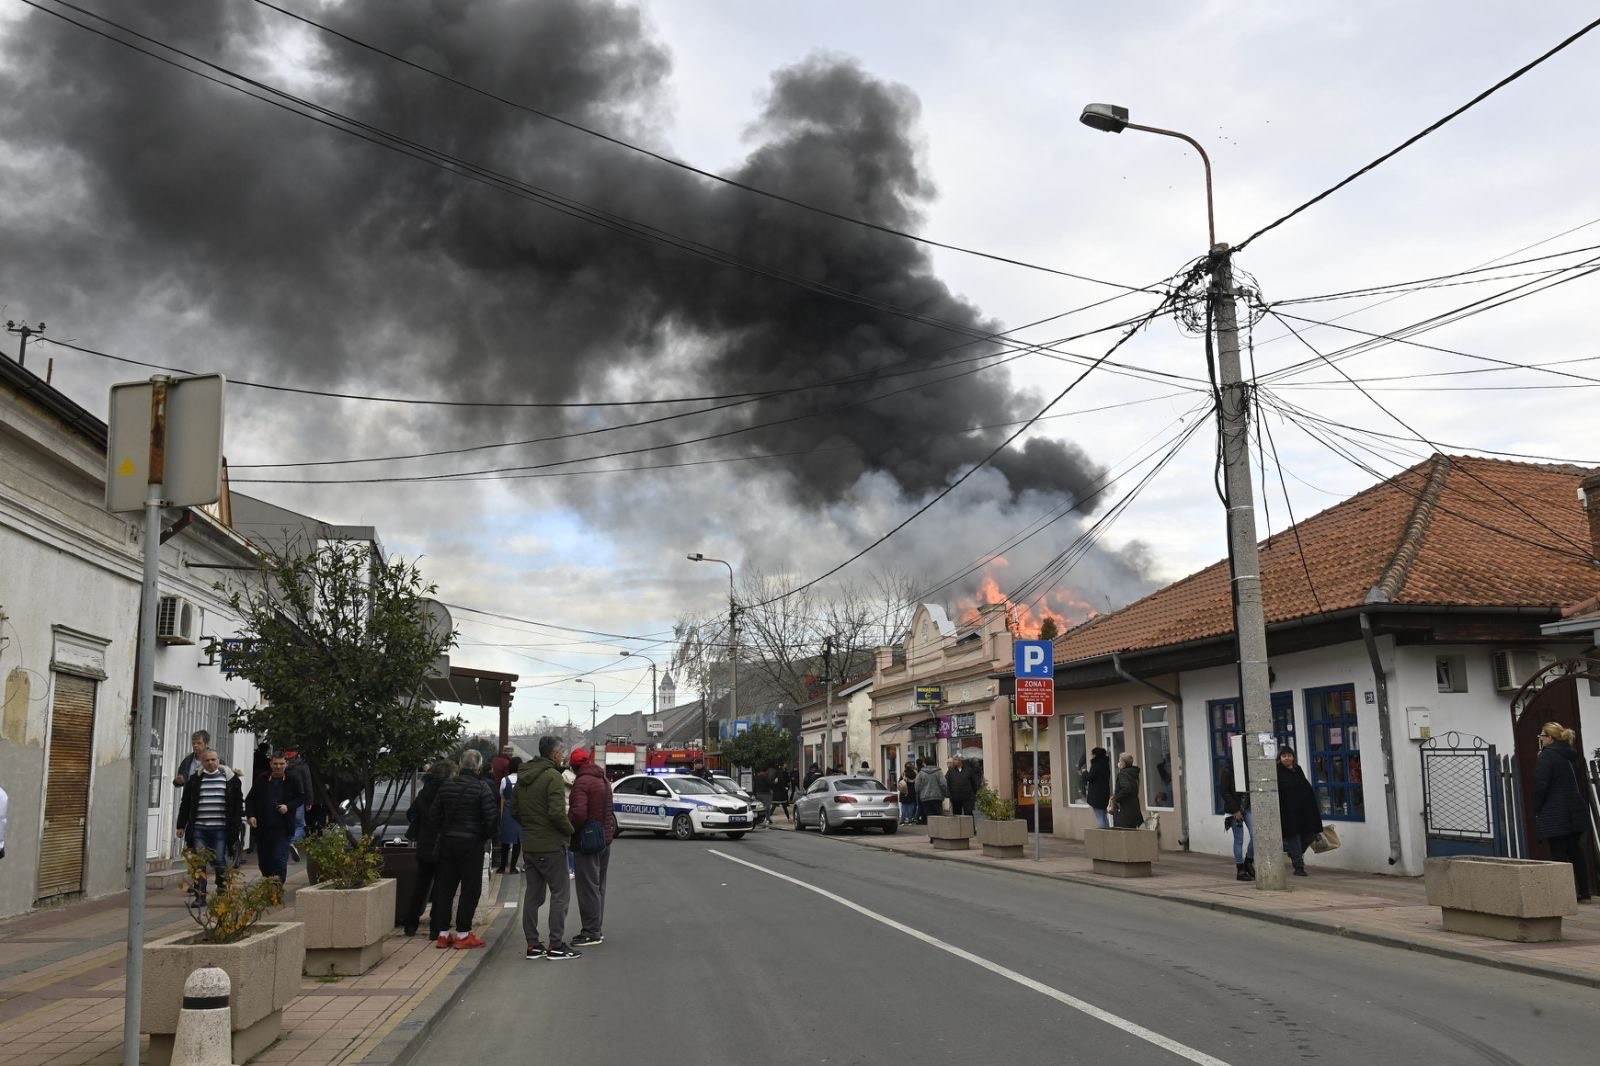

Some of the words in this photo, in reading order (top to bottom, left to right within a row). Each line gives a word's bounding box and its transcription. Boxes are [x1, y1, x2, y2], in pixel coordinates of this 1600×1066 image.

[1024, 645, 1044, 673] P
[1024, 680, 1042, 688] ZONA
[621, 804, 656, 814] ПОЛИЦИЈА
